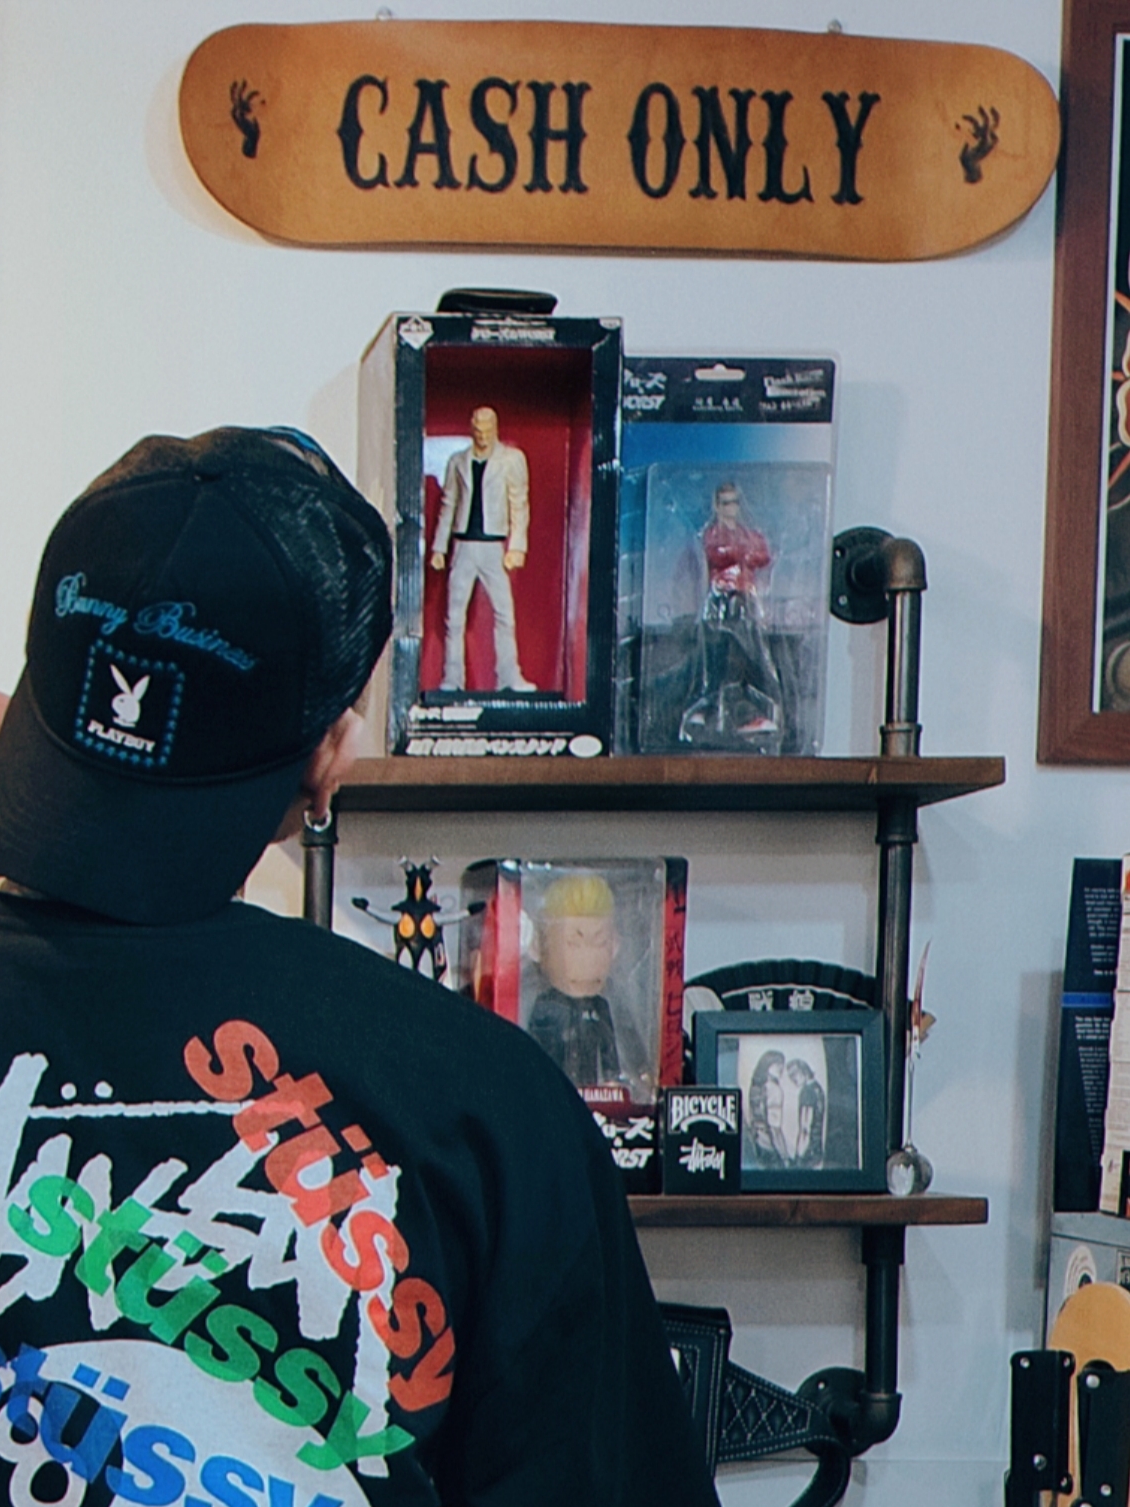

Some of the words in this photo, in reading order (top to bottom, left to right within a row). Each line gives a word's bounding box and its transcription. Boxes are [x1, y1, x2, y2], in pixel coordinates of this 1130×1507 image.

[336, 74, 593, 194] CASH
[627, 81, 881, 206] ONLY
[87, 719, 155, 753] PLAYBOY
[671, 1094, 737, 1131] BICYCLE
